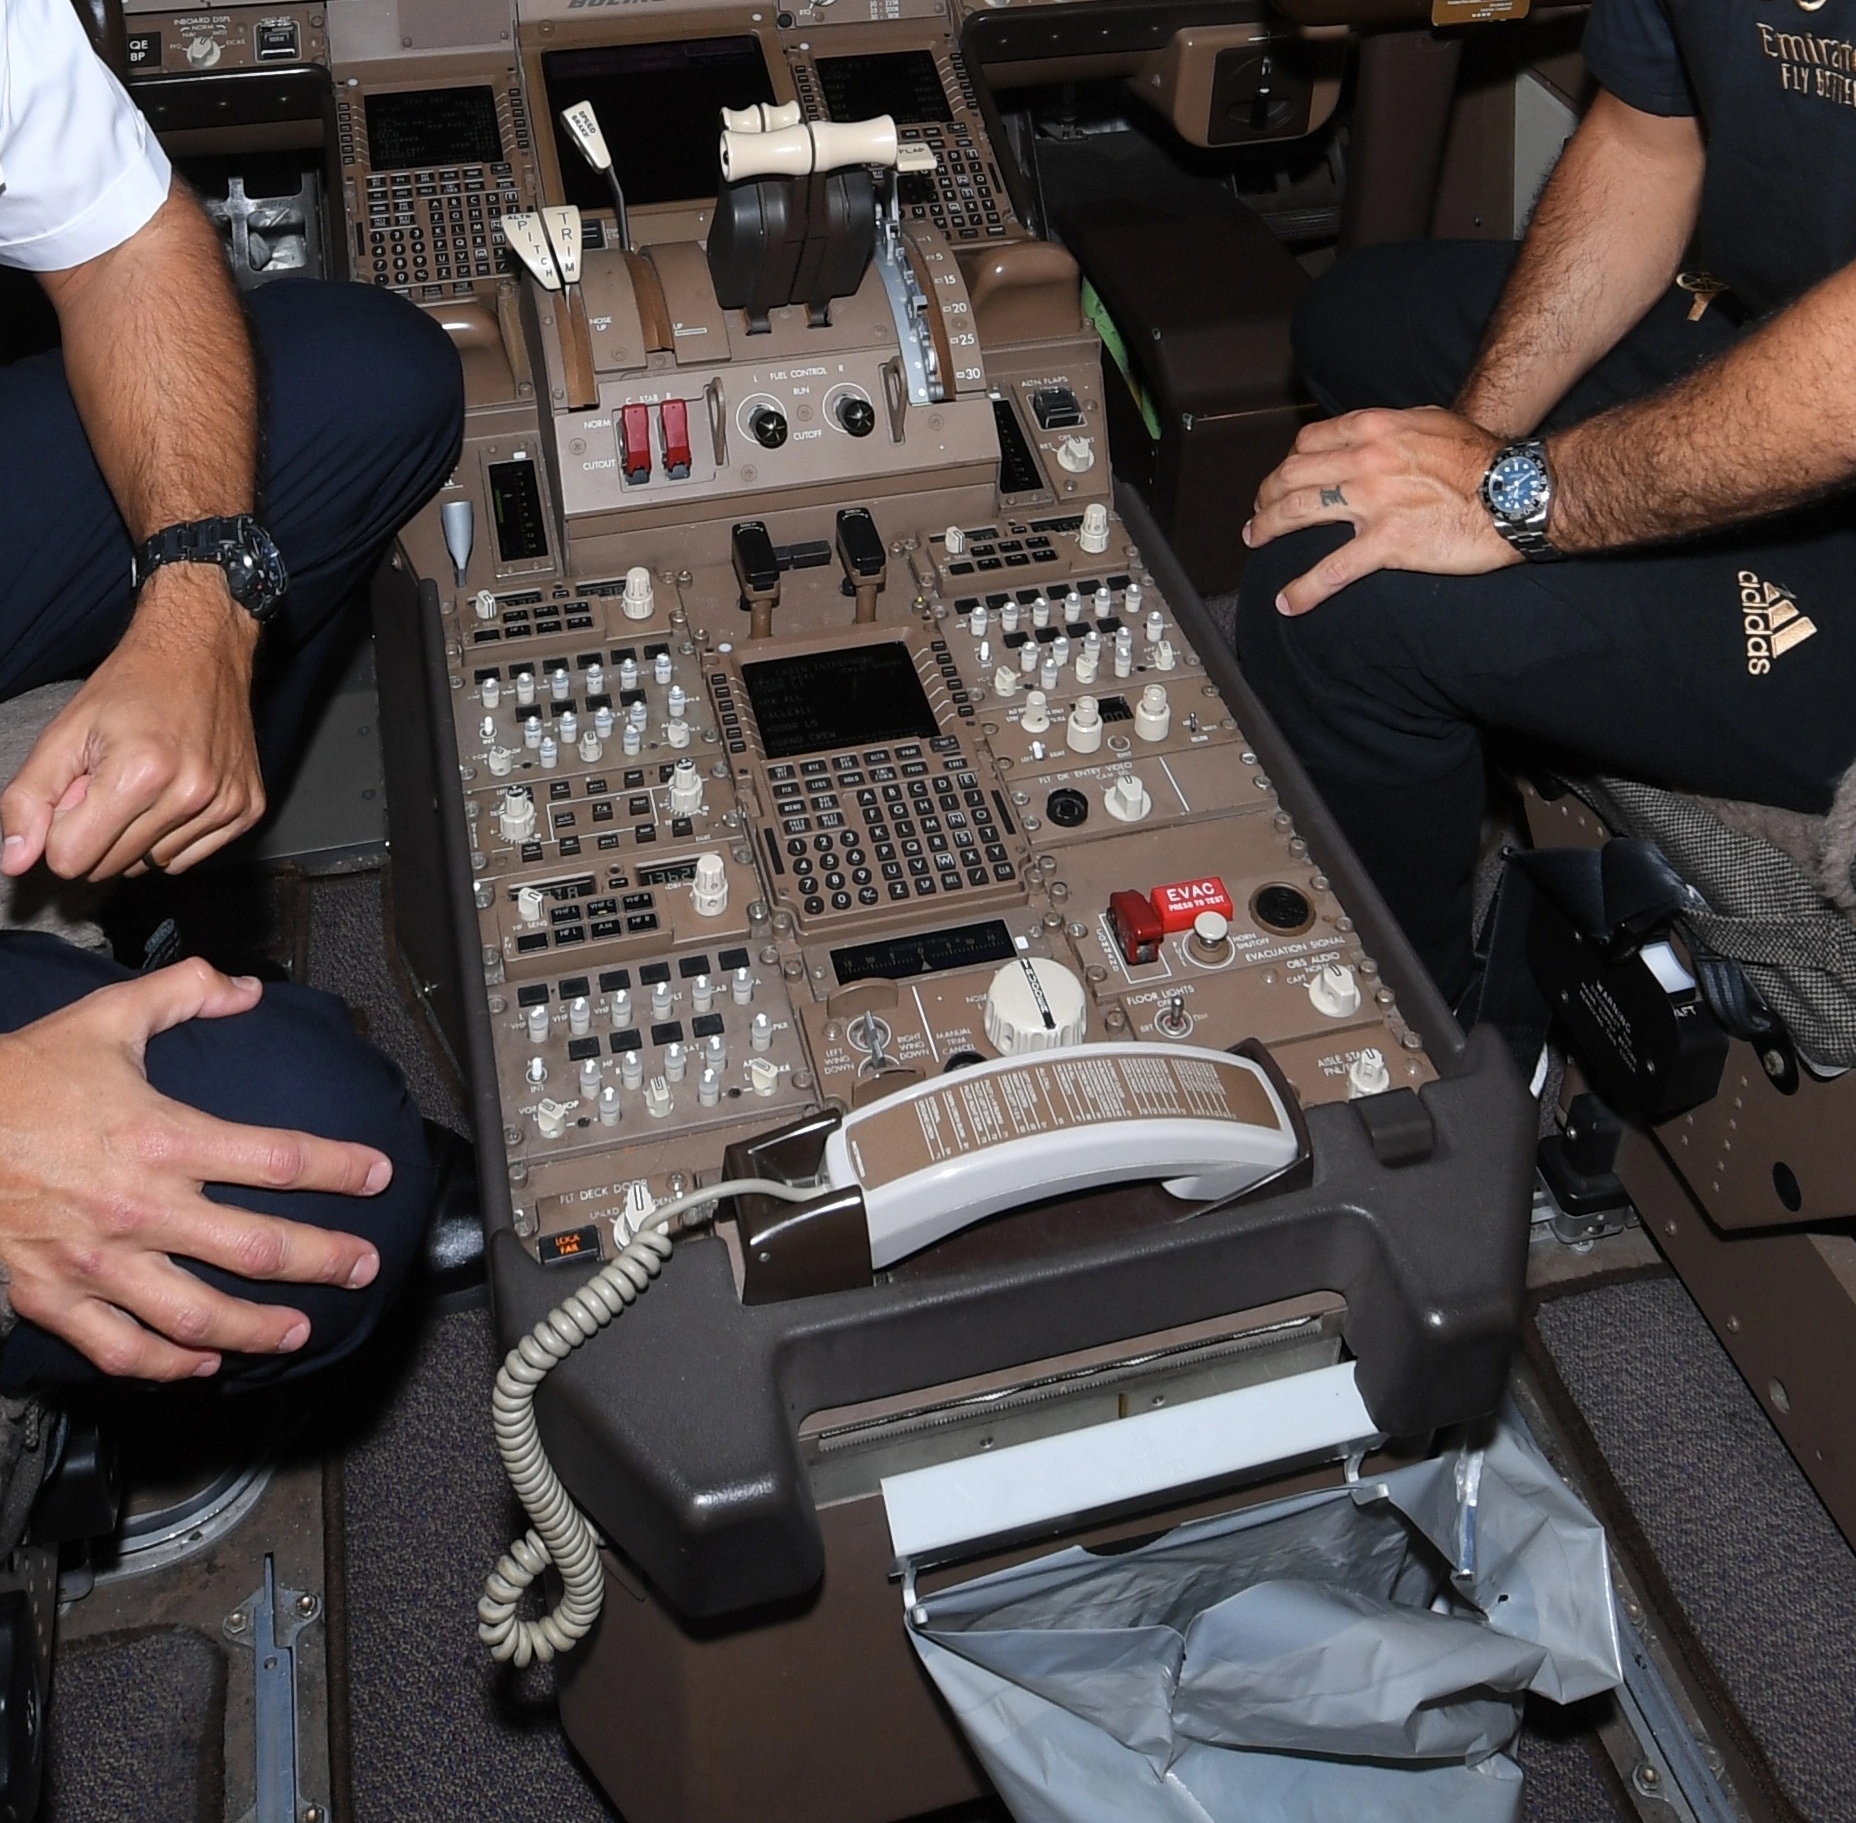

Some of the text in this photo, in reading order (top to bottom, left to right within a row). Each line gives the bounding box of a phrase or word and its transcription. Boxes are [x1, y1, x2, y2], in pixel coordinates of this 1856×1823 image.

[1782, 63, 1809, 94] FLY
[571, 114, 590, 138] BRAKE
[578, 110, 597, 134] SPEED
[898, 147, 925, 155] FLAP
[518, 221, 553, 278] PITCH
[557, 212, 575, 272] TRIM
[770, 367, 827, 380] FUEL CONTROL
[793, 387, 810, 395] RUN
[584, 419, 611, 428] NORM
[793, 430, 822, 441] CUTOFF
[583, 459, 615, 470] CUTOUT
[1738, 570, 1773, 675] adidas
[1166, 882, 1215, 902] EVAC
[1168, 901, 1194, 912] PRESS
[1206, 896, 1225, 906] TEST
[1233, 932, 1257, 943] HORN
[1236, 939, 1270, 950] SHUTOFF
[1245, 936, 1346, 962] EVACUATION SIGNAL
[1286, 951, 1341, 969] OBS AUDIO
[1126, 985, 1195, 1006] FLOOR LIGHTS
[560, 1185, 608, 1204] FLT DECK
